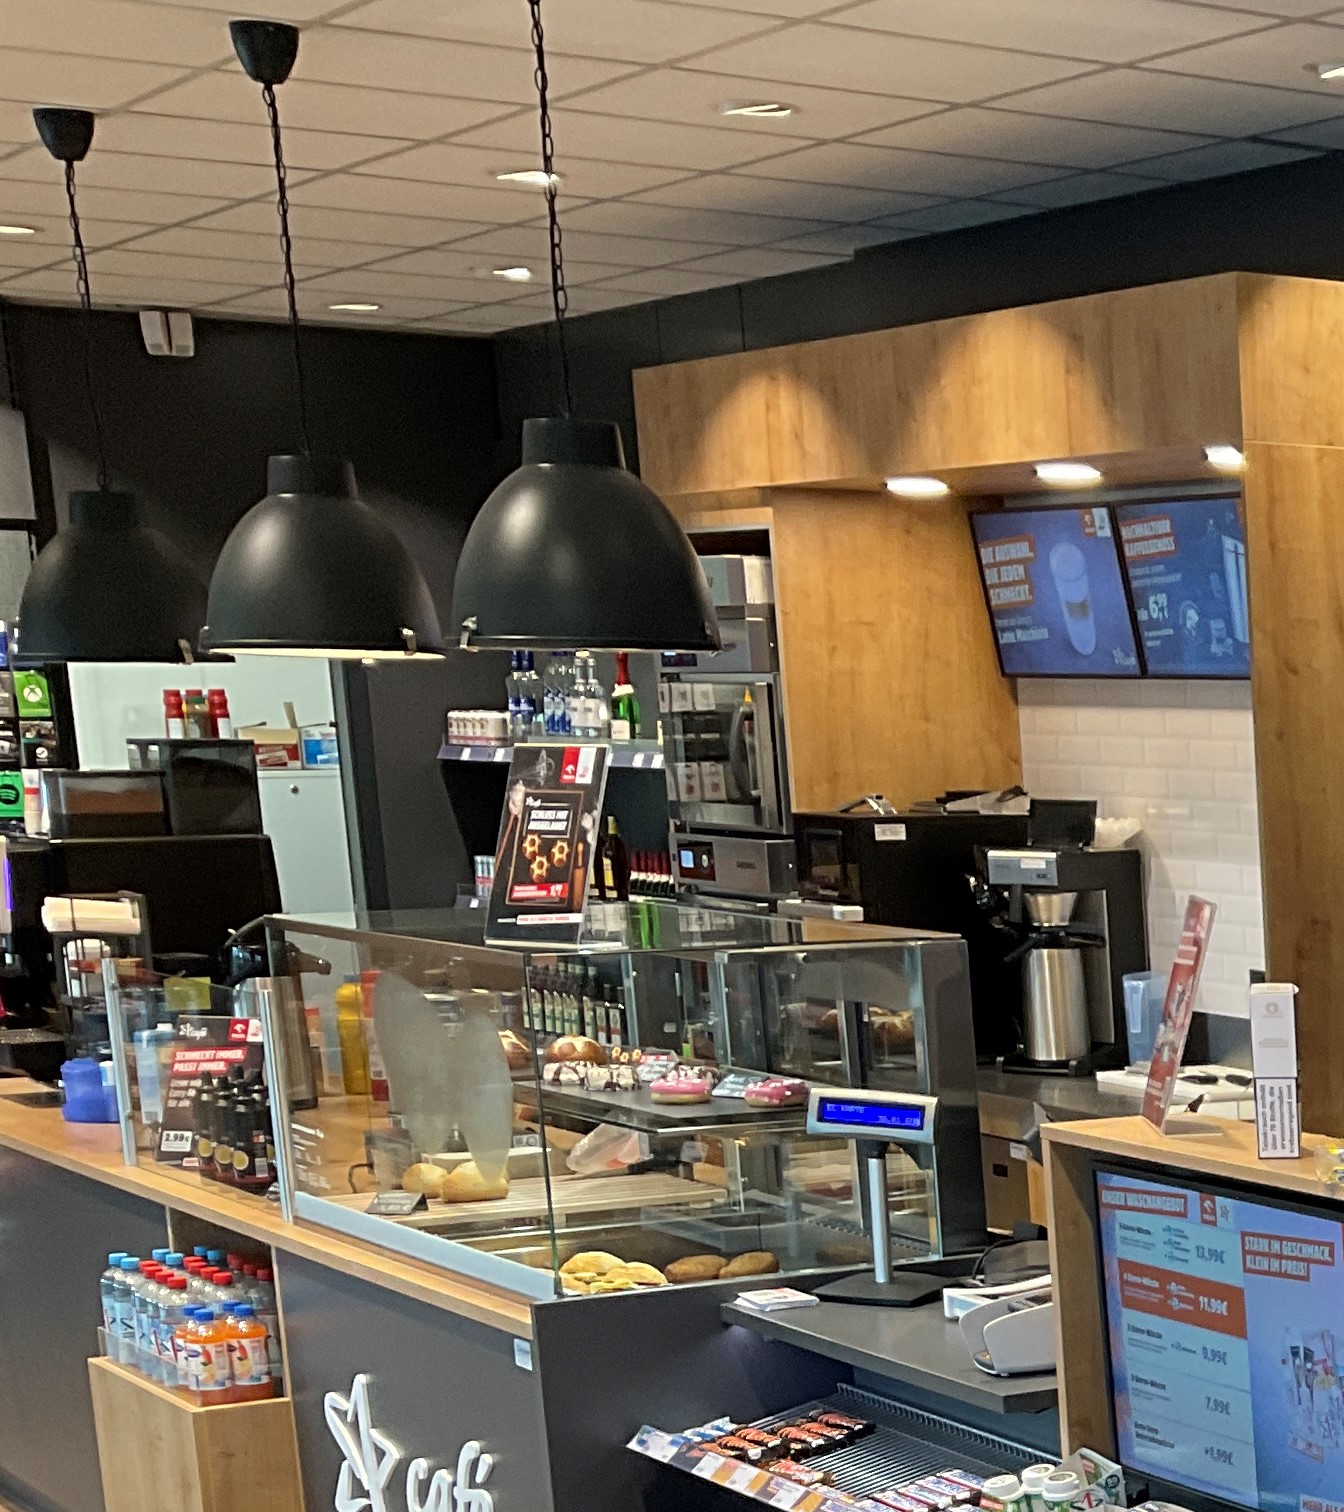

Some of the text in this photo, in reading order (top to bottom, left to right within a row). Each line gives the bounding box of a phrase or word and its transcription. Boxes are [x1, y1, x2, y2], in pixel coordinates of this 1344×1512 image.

[175, 1050, 244, 1060] SCHMECKT IMMER.
[173, 1061, 227, 1071] PASST IMMER.
